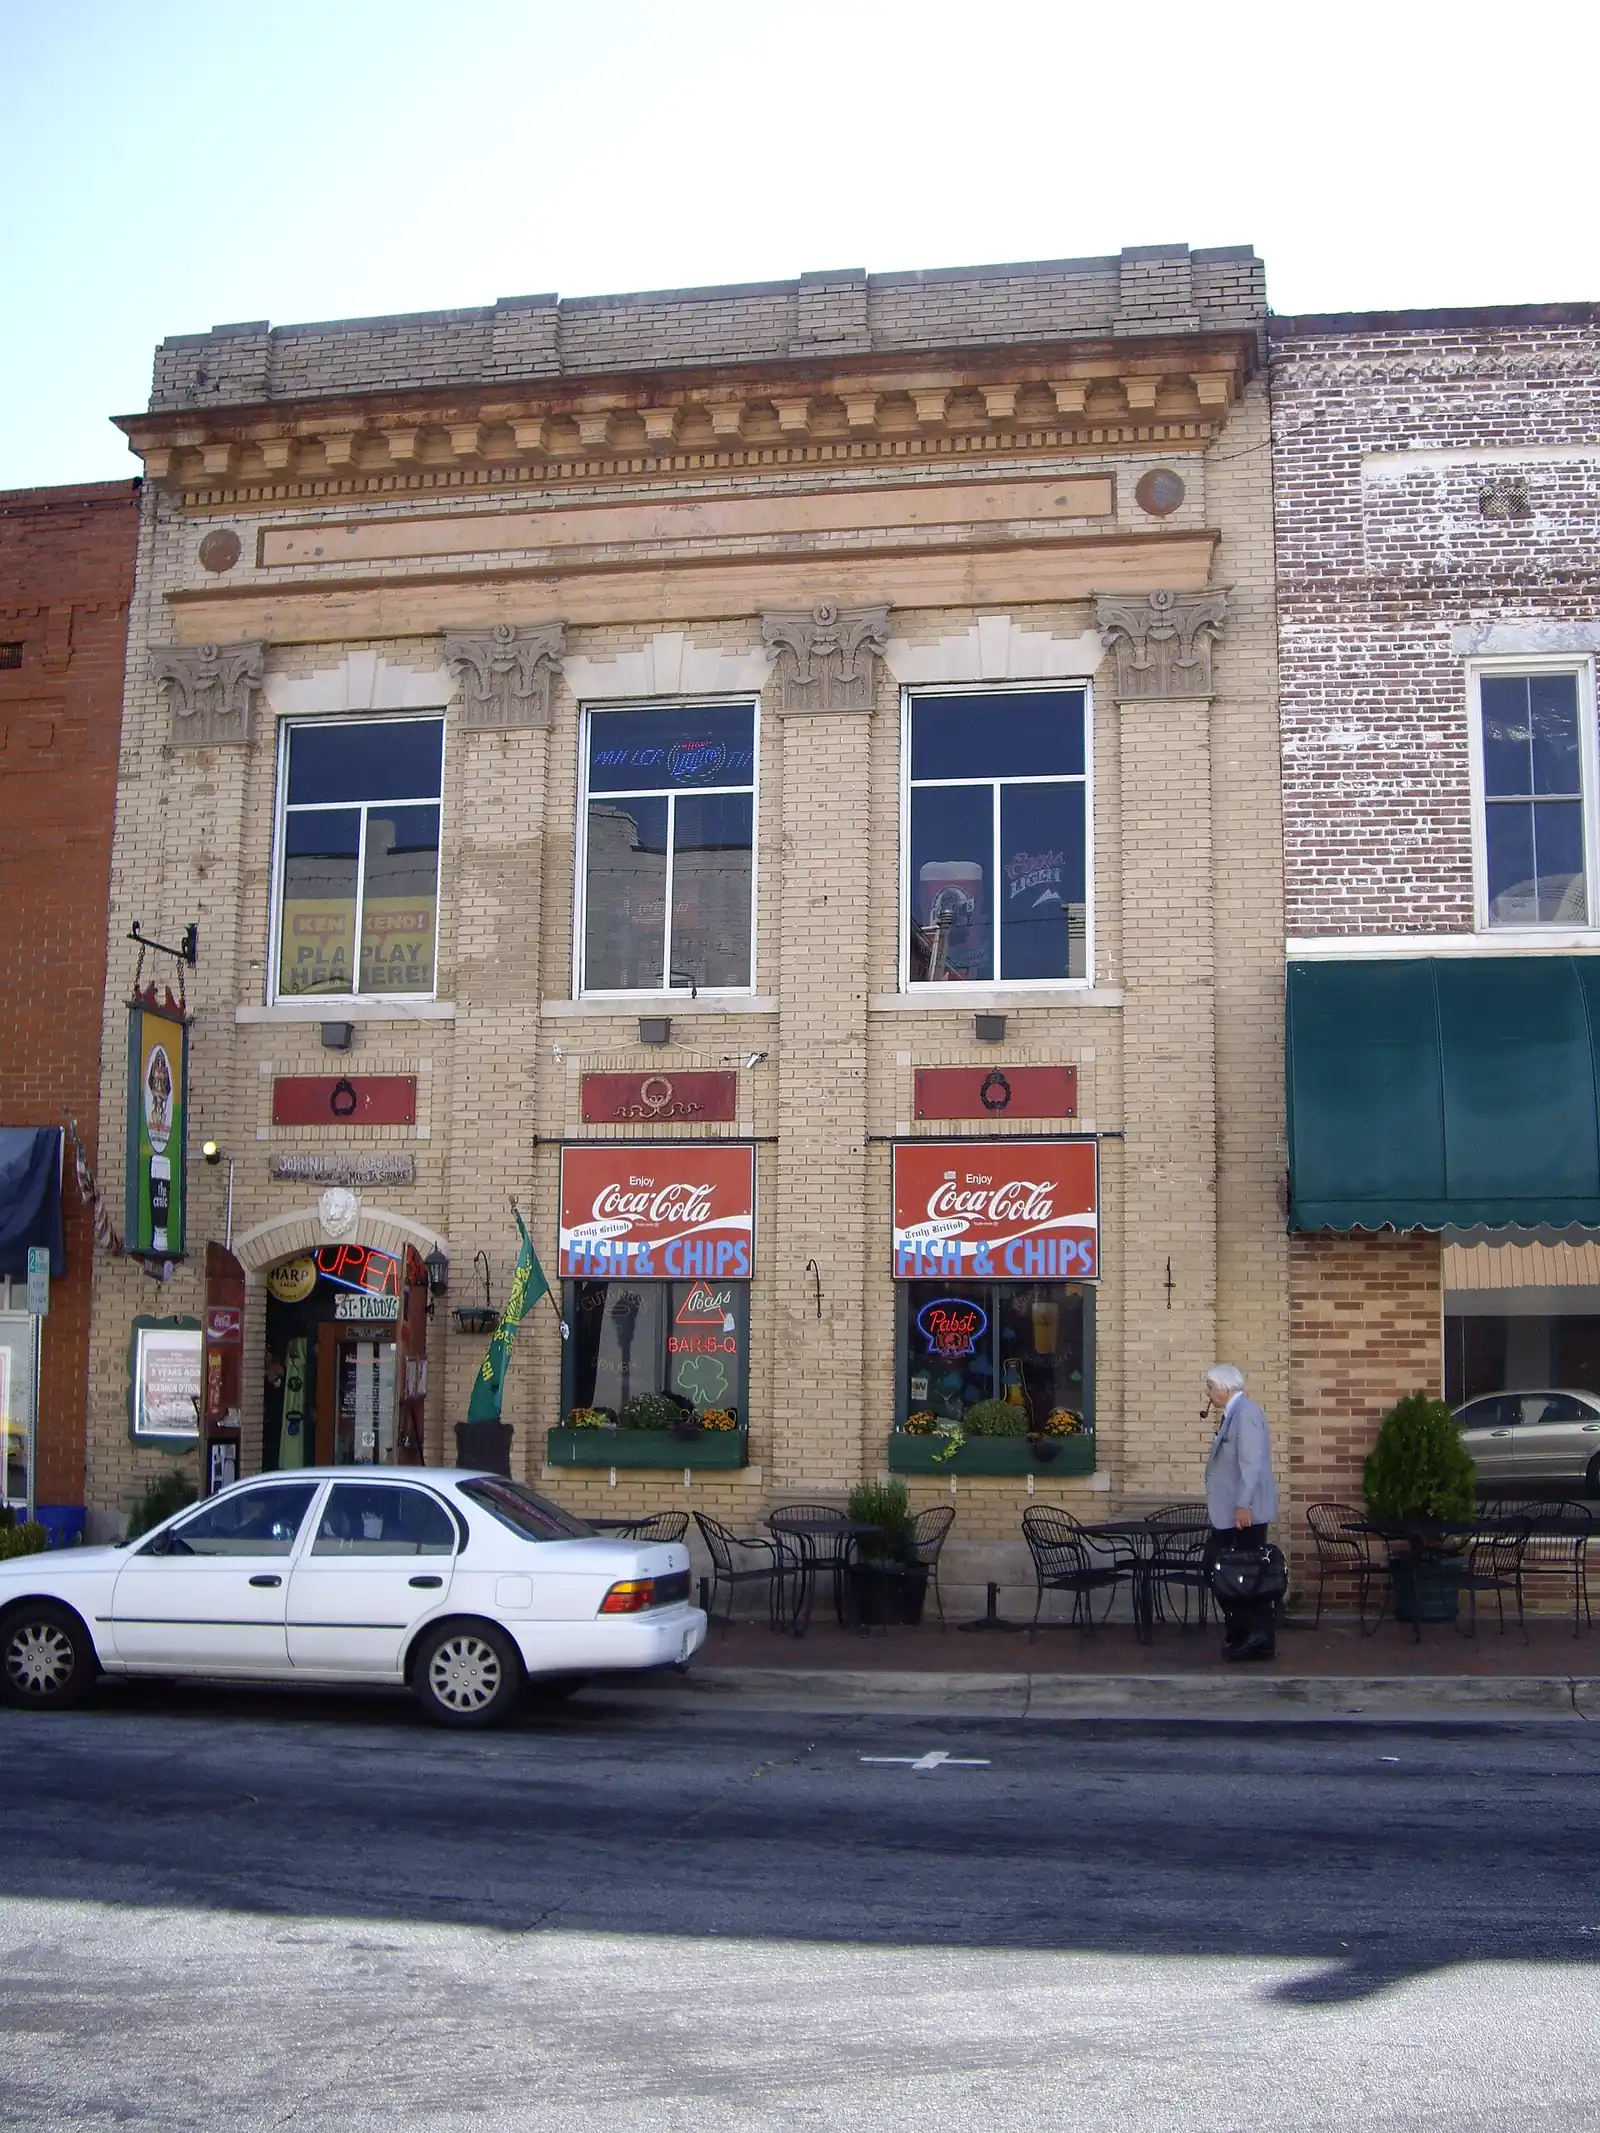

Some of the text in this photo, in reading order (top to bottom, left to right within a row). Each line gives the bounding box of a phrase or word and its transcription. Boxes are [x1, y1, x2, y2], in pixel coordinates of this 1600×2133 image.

[299, 917, 345, 933] KEN
[297, 946, 345, 964] PLA
[363, 943, 422, 963] PLAY
[629, 1176, 655, 1187] Enjoy
[966, 1173, 993, 1185] Enjoy
[592, 1183, 717, 1222] Coca-Cola
[927, 1181, 1059, 1221] Coca-Cola
[573, 1222, 630, 1238] Truly British
[905, 1221, 964, 1240] Truly British
[568, 1240, 749, 1275] FISH & CHIPS
[898, 1239, 1093, 1275] FISH & CHIPS
[270, 1268, 308, 1282] HARP
[688, 1290, 731, 1312] Bass
[929, 1309, 977, 1332] Pabst
[668, 1337, 736, 1353] BAR-B-Q
